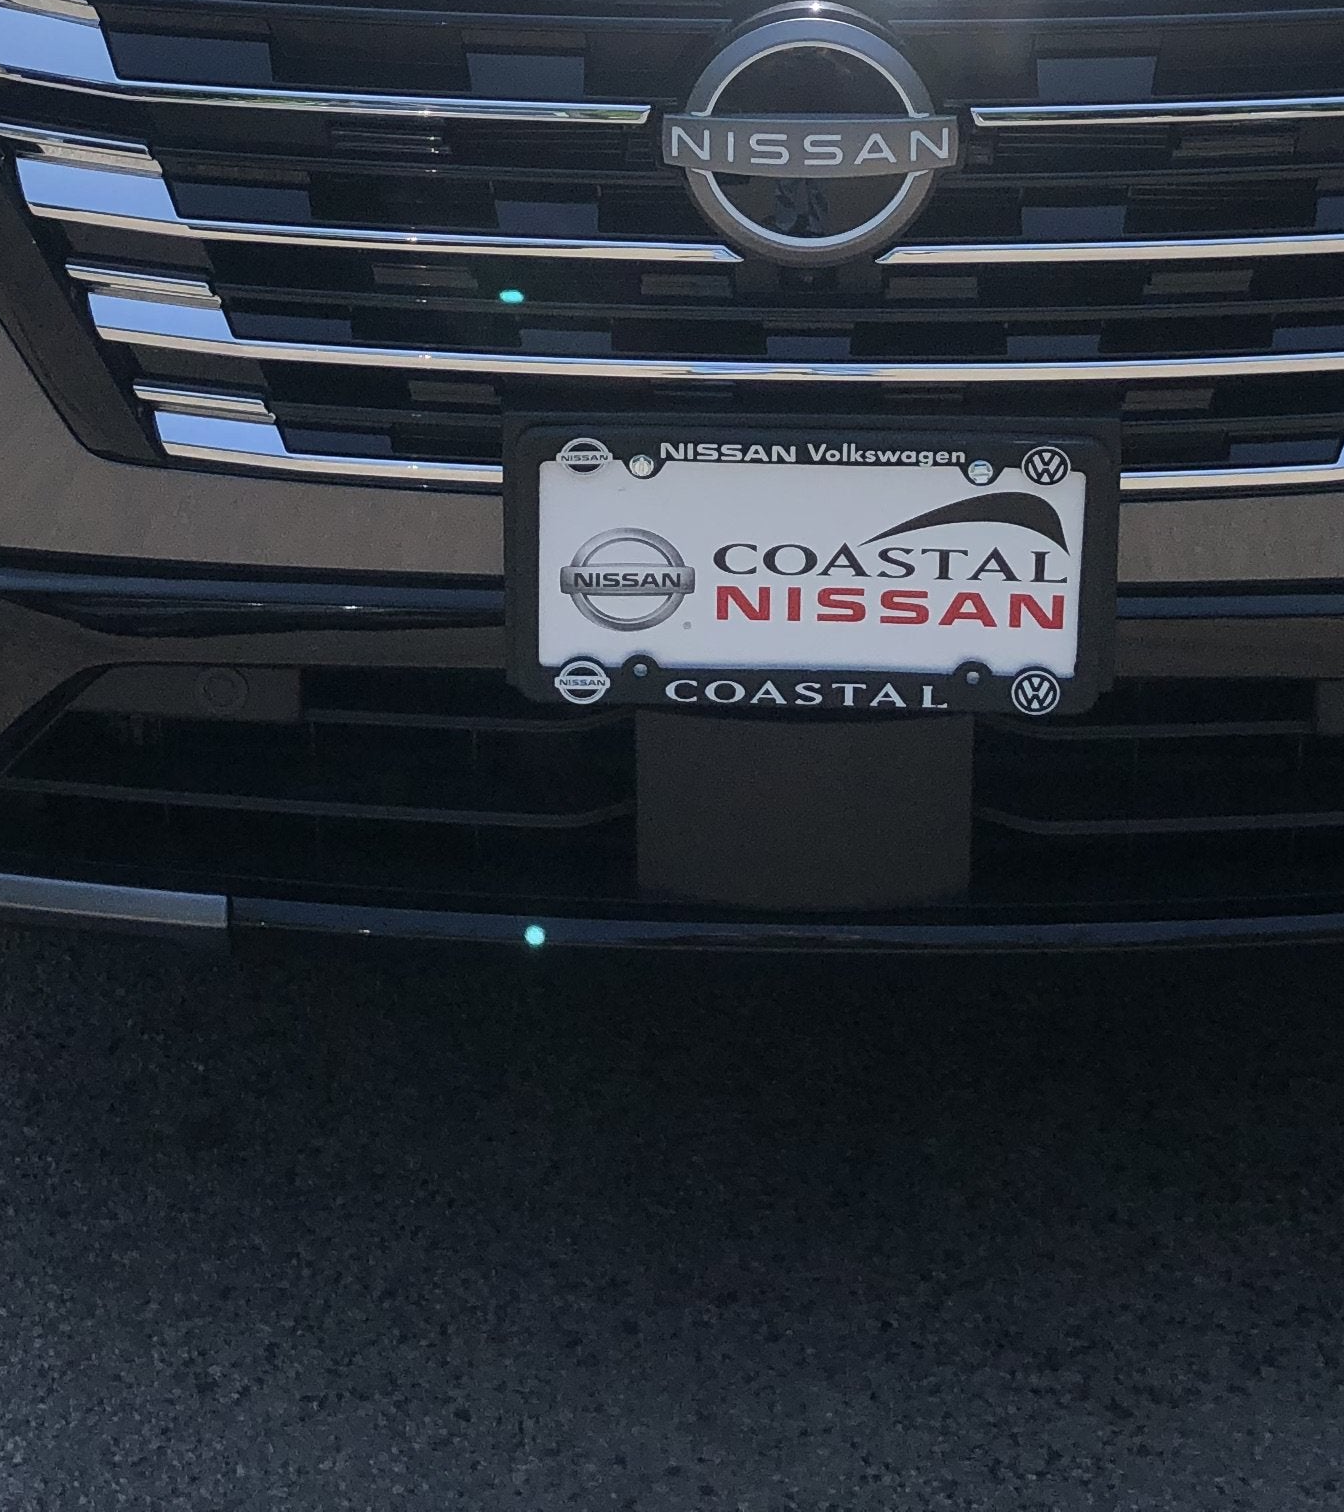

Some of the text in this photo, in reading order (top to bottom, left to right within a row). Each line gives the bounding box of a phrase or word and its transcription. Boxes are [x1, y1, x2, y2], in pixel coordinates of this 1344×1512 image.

[671, 125, 949, 166] NISSAN
[560, 454, 609, 463] NISSAN
[659, 442, 966, 468] NISSAN Volkswagen
[712, 542, 1068, 584] COASTAL
[573, 572, 681, 588] NISSAN
[715, 585, 1065, 630] NISSAN
[558, 677, 607, 687] NISSAN
[665, 680, 948, 709] COASTAL
